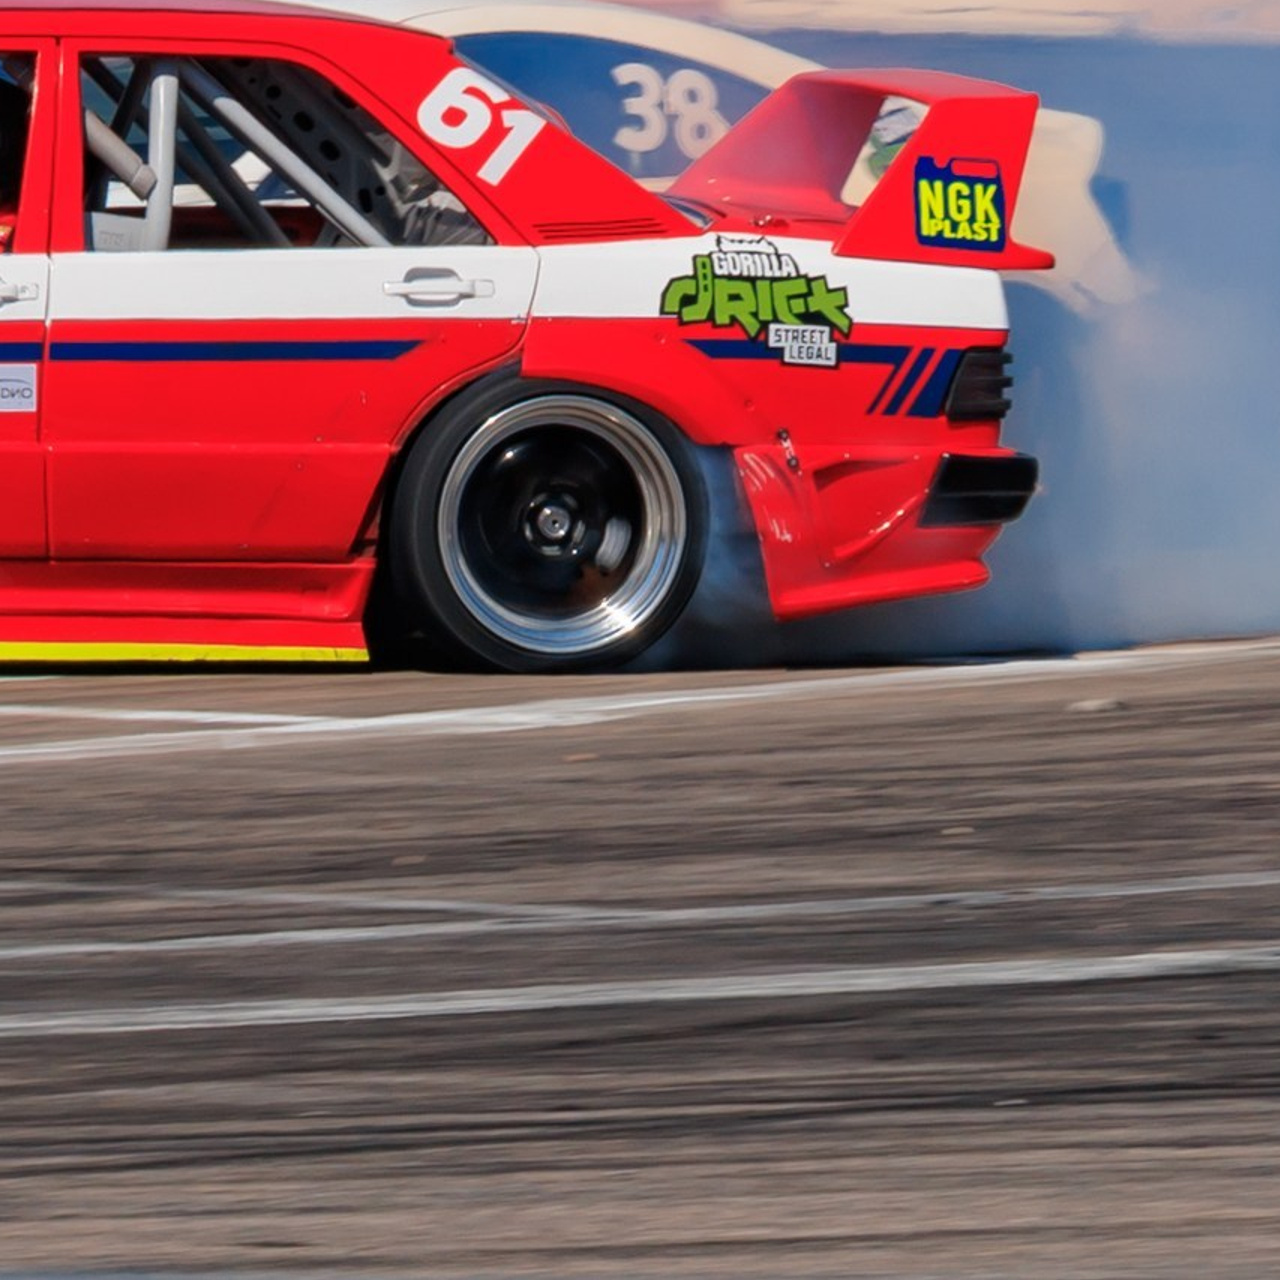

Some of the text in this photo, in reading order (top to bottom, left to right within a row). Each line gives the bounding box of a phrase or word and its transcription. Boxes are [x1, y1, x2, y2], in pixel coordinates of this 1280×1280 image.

[610, 63, 731, 160] 38
[417, 67, 547, 186] 61
[919, 179, 999, 225] NGK
[923, 219, 1001, 242] PLAST
[711, 252, 797, 277] GORILLA
[773, 328, 826, 345] STREET
[789, 344, 832, 361] LEGAL
